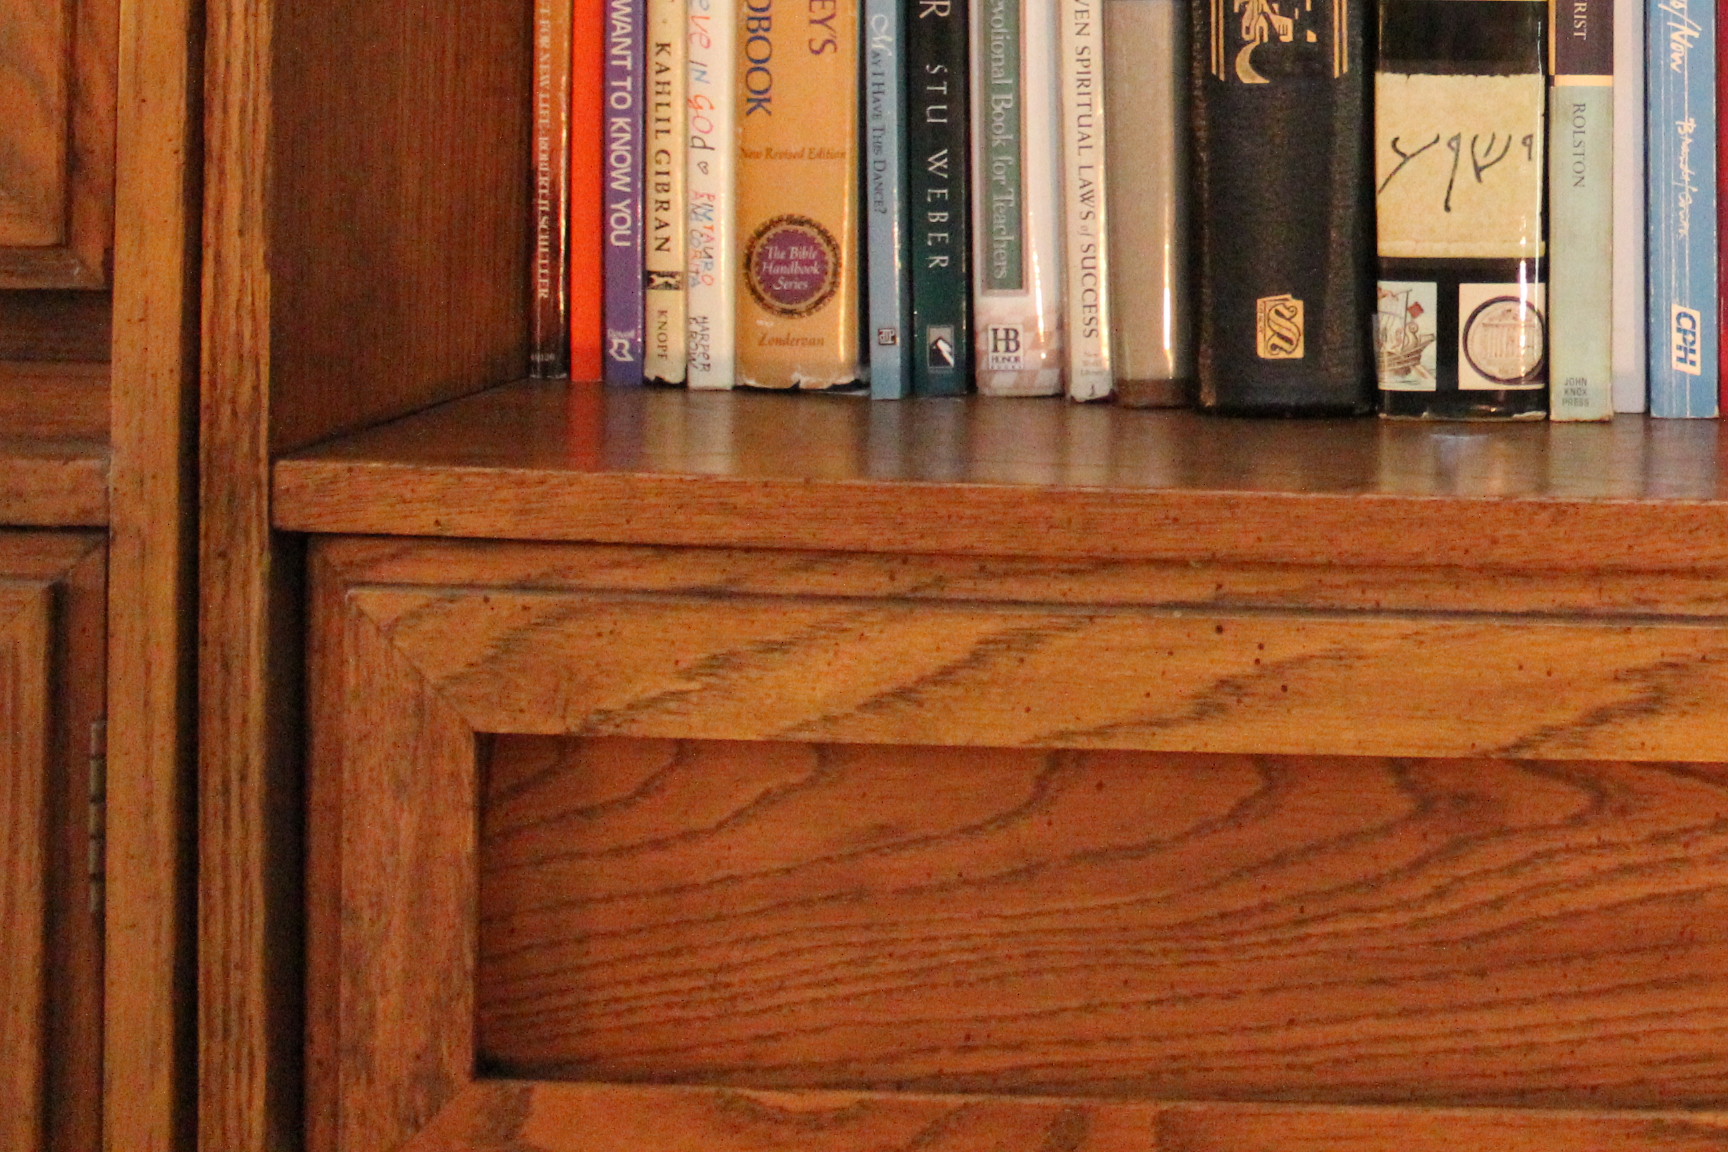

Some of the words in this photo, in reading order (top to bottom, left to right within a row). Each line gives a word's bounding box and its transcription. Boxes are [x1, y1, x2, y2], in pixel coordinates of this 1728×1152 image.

[610, 78, 632, 110] TO
[654, 41, 674, 139] KAHLIL
[926, 63, 948, 124] STU
[1075, 45, 1093, 156] SPIRITUAL
[990, 93, 1014, 154] Book
[1573, 102, 1586, 188] ROLSTON
[610, 117, 632, 192] KNOW
[764, 147, 805, 160] Revised
[807, 147, 847, 160] Edition
[990, 156, 1014, 185] for
[653, 149, 673, 254] GIBRAN
[927, 148, 950, 269] WEBER
[1077, 165, 1096, 220] LAWS
[610, 198, 632, 247] YOU
[990, 188, 1015, 279] Teachers
[761, 260, 821, 275] Handbook
[766, 246, 788, 261] The
[789, 246, 818, 261] Bible
[772, 275, 808, 291] Series
[1080, 243, 1098, 339] SUCCESS
[656, 309, 669, 361] KNOPF
[758, 333, 825, 348] Zondervan
[1675, 311, 1697, 367] CPH
[1562, 397, 1590, 407] PRESS
[1564, 377, 1588, 387] JOHN
[1564, 388, 1588, 397] KNOX
